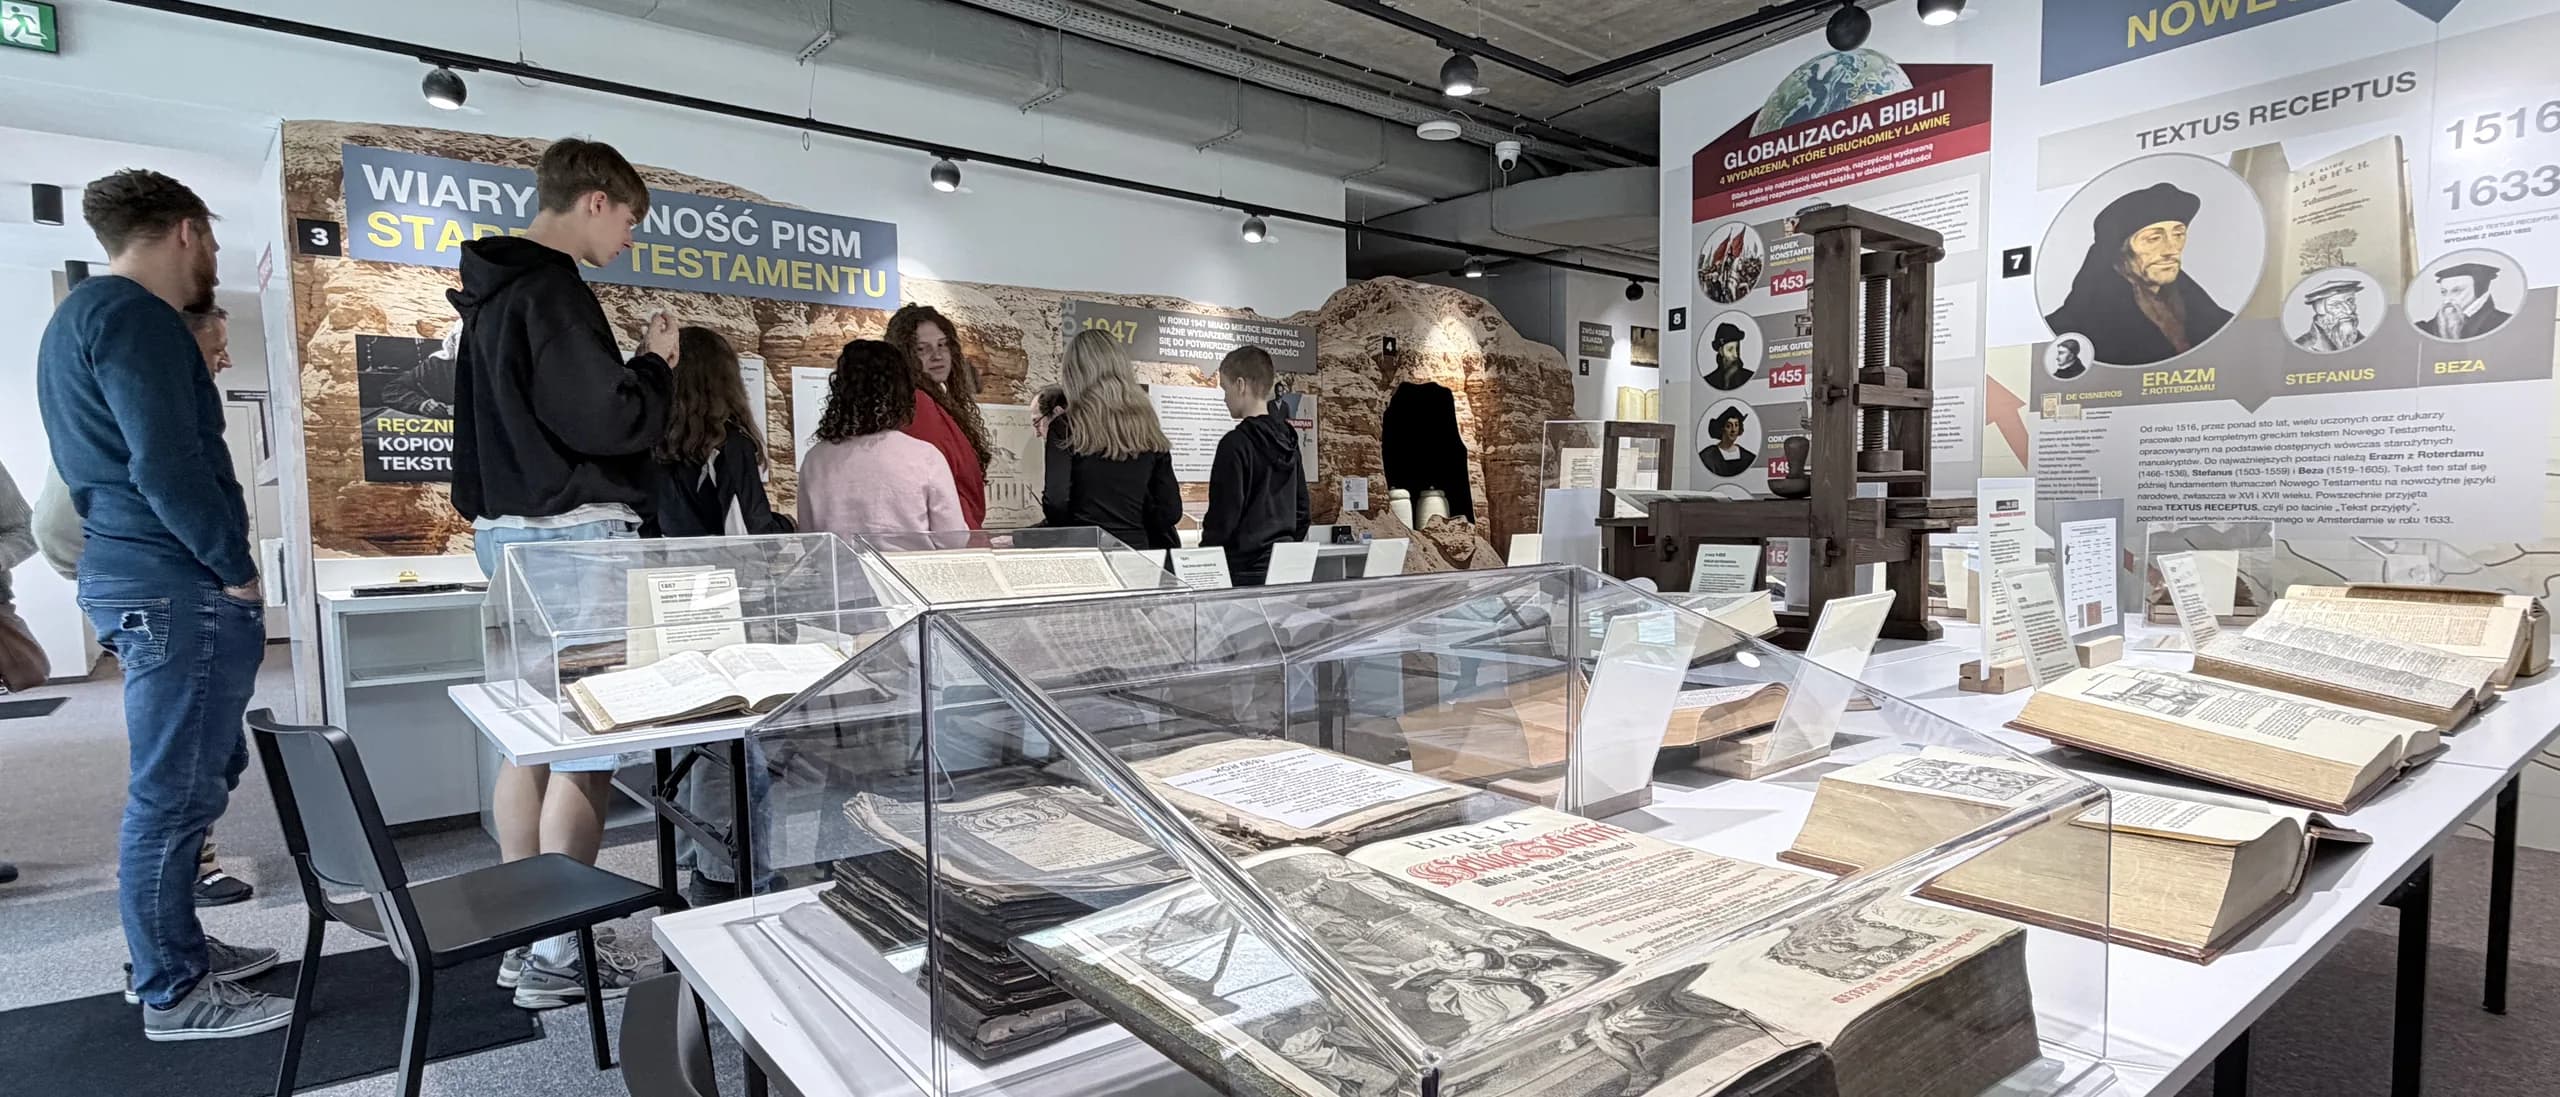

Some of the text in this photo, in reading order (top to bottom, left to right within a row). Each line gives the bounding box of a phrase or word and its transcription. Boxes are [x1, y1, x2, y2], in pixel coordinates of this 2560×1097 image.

[2127, 0, 2305, 48] NOWE
[2136, 71, 2417, 150] TEXTUS RECEPTUS
[1724, 90, 1945, 170] GLOBALIZACJA BIBLII
[2446, 100, 2560, 150] 1516
[1720, 113, 1951, 185] 4 WYDARZENIA, KTÓRE URUCHOMIŁY LAWINĘ
[2443, 165, 2560, 210] 1633
[311, 228, 329, 246] 3
[771, 220, 861, 259] PISM
[1770, 240, 1799, 252] UPADEK
[1770, 246, 1814, 261] KONSTANTY
[630, 242, 887, 298] TESTAMENTU
[2010, 254, 2024, 270] 7
[1773, 275, 1804, 292] 1453
[1168, 317, 1189, 325] ROKU
[1208, 321, 1230, 330] MIAŁO
[1232, 324, 1263, 333] MIEJSCE
[1262, 327, 1298, 337] NIEZWYKLE
[1673, 313, 1681, 325] 8
[1083, 317, 1138, 344] 1947
[1159, 326, 1304, 347] WAŻNE WYDARZENIE, KTÓRE PRZYCZYNIŁO
[1160, 337, 1174, 346] SIĘ
[1173, 338, 1183, 346] DO
[1386, 342, 1392, 351] 4
[1769, 341, 1813, 353] DRUK GUTEN
[1160, 348, 1213, 359] PISM STAREGO
[2434, 359, 2486, 375] BEZA
[1771, 369, 1802, 384] 1455
[2143, 368, 2216, 387] ERAZM
[2285, 368, 2376, 385] STEFANUS
[2079, 390, 2123, 400] CISNEROS
[2150, 384, 2216, 395] ROTTERDAMU
[377, 418, 454, 435] RĘCZNI
[2227, 421, 2256, 429] ponad
[2320, 416, 2368, 425] uczonych
[2397, 412, 2444, 421] drukarzy
[2260, 432, 2297, 441] greckim
[2389, 425, 2455, 435] Testamentu,
[2139, 448, 2209, 456] opracowywanym
[2275, 443, 2330, 451] dostępnych
[2384, 437, 2453, 447] starożytnych
[2219, 456, 2292, 465] najważniejszych
[2418, 450, 2484, 458] Roterdamu
[2448, 463, 2467, 471] stał
[2471, 464, 2487, 472] się
[2280, 480, 2319, 488] Nowego
[2401, 477, 2460, 486] nowożytne
[2464, 476, 2495, 486] języki
[2385, 491, 2427, 499] przyjęta
[2263, 504, 2283, 512] czyli
[2424, 516, 2454, 524] 1633.
[1405, 820, 1531, 850] BIBLIA
